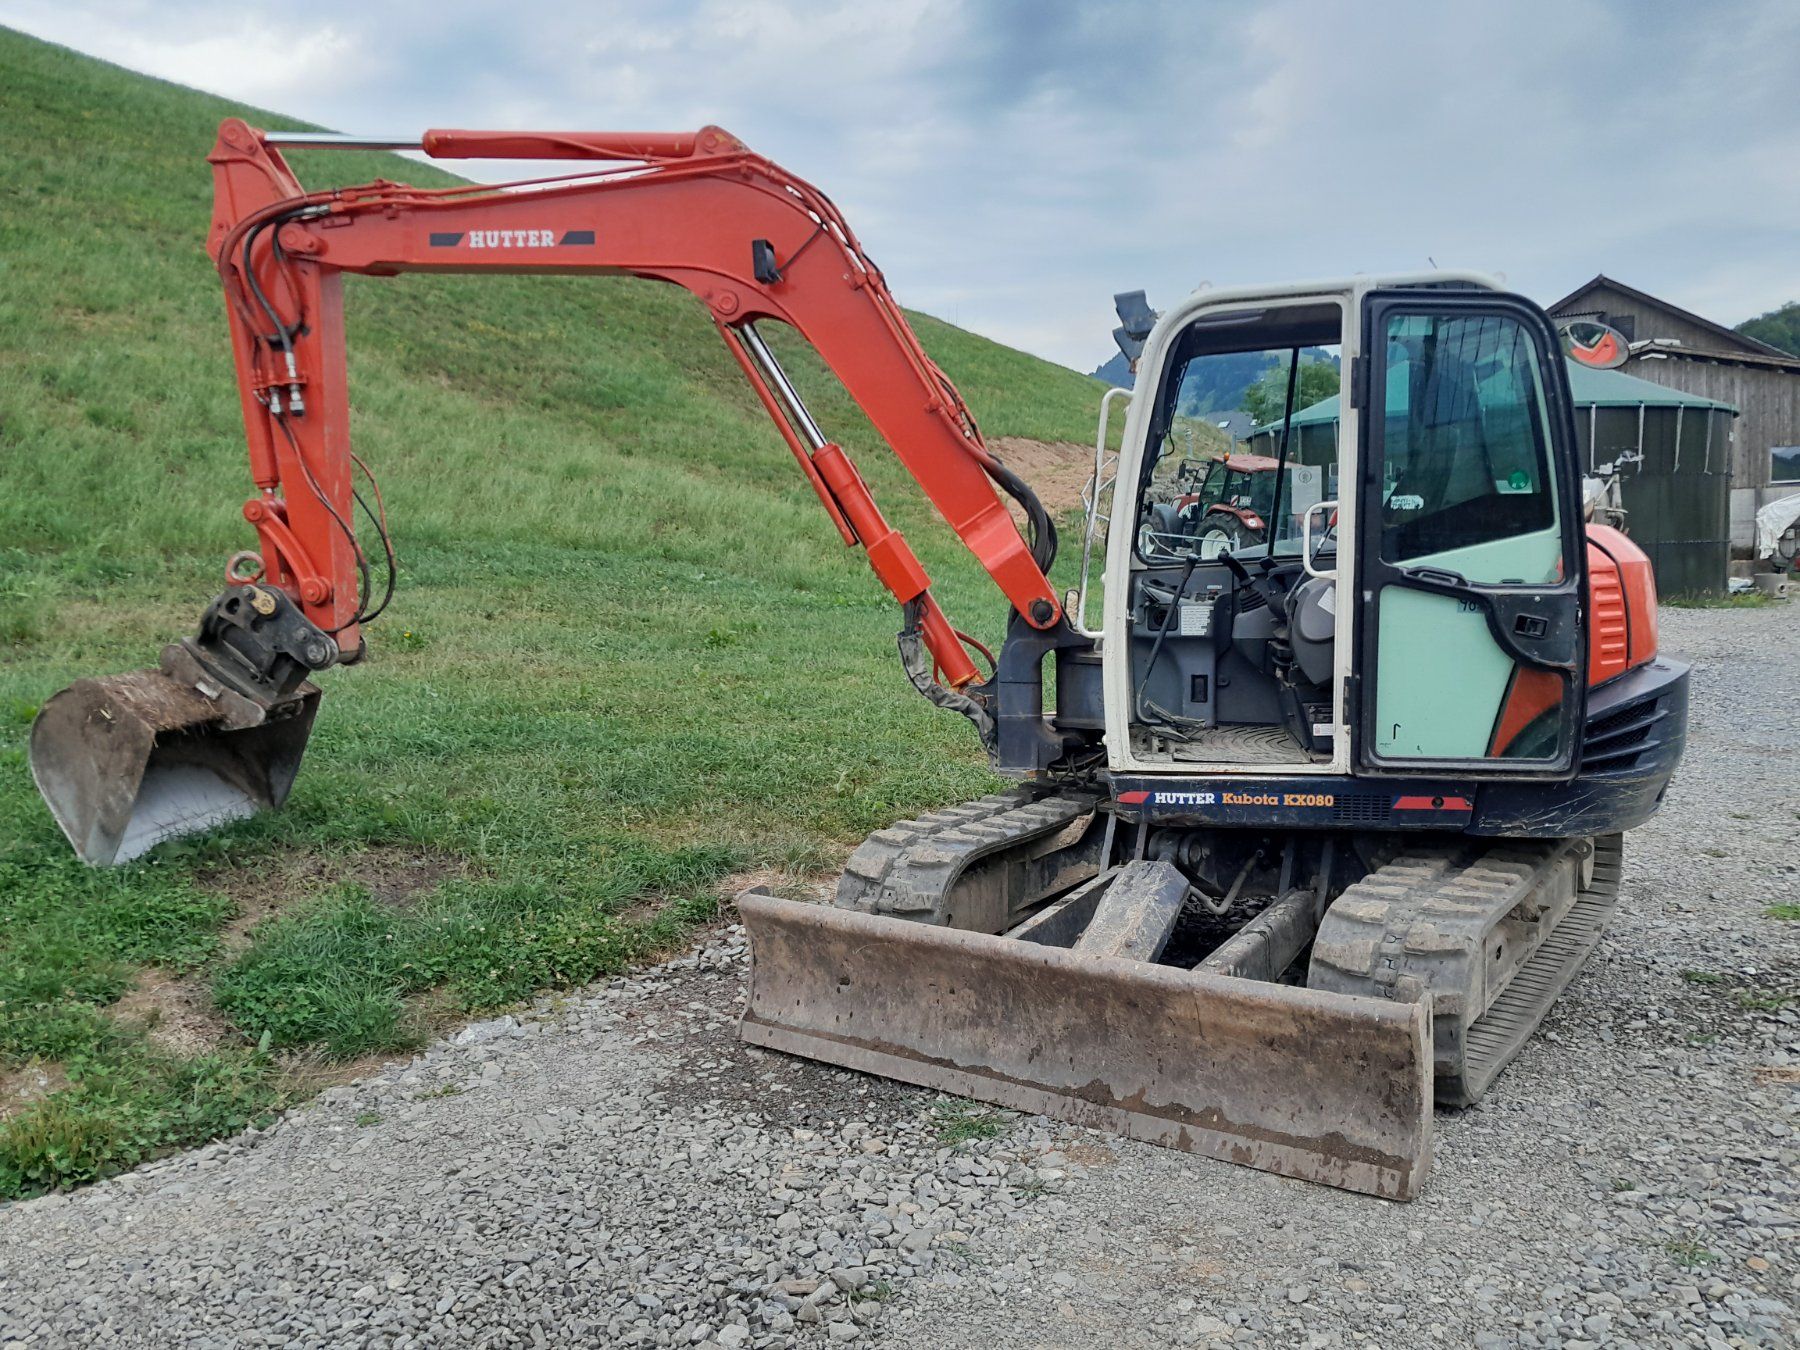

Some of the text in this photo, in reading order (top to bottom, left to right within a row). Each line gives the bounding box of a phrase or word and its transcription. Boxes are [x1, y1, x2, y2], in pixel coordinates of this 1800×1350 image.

[468, 230, 555, 248] HUTTER
[1154, 792, 1334, 807] HUTTER Kubota KX080
